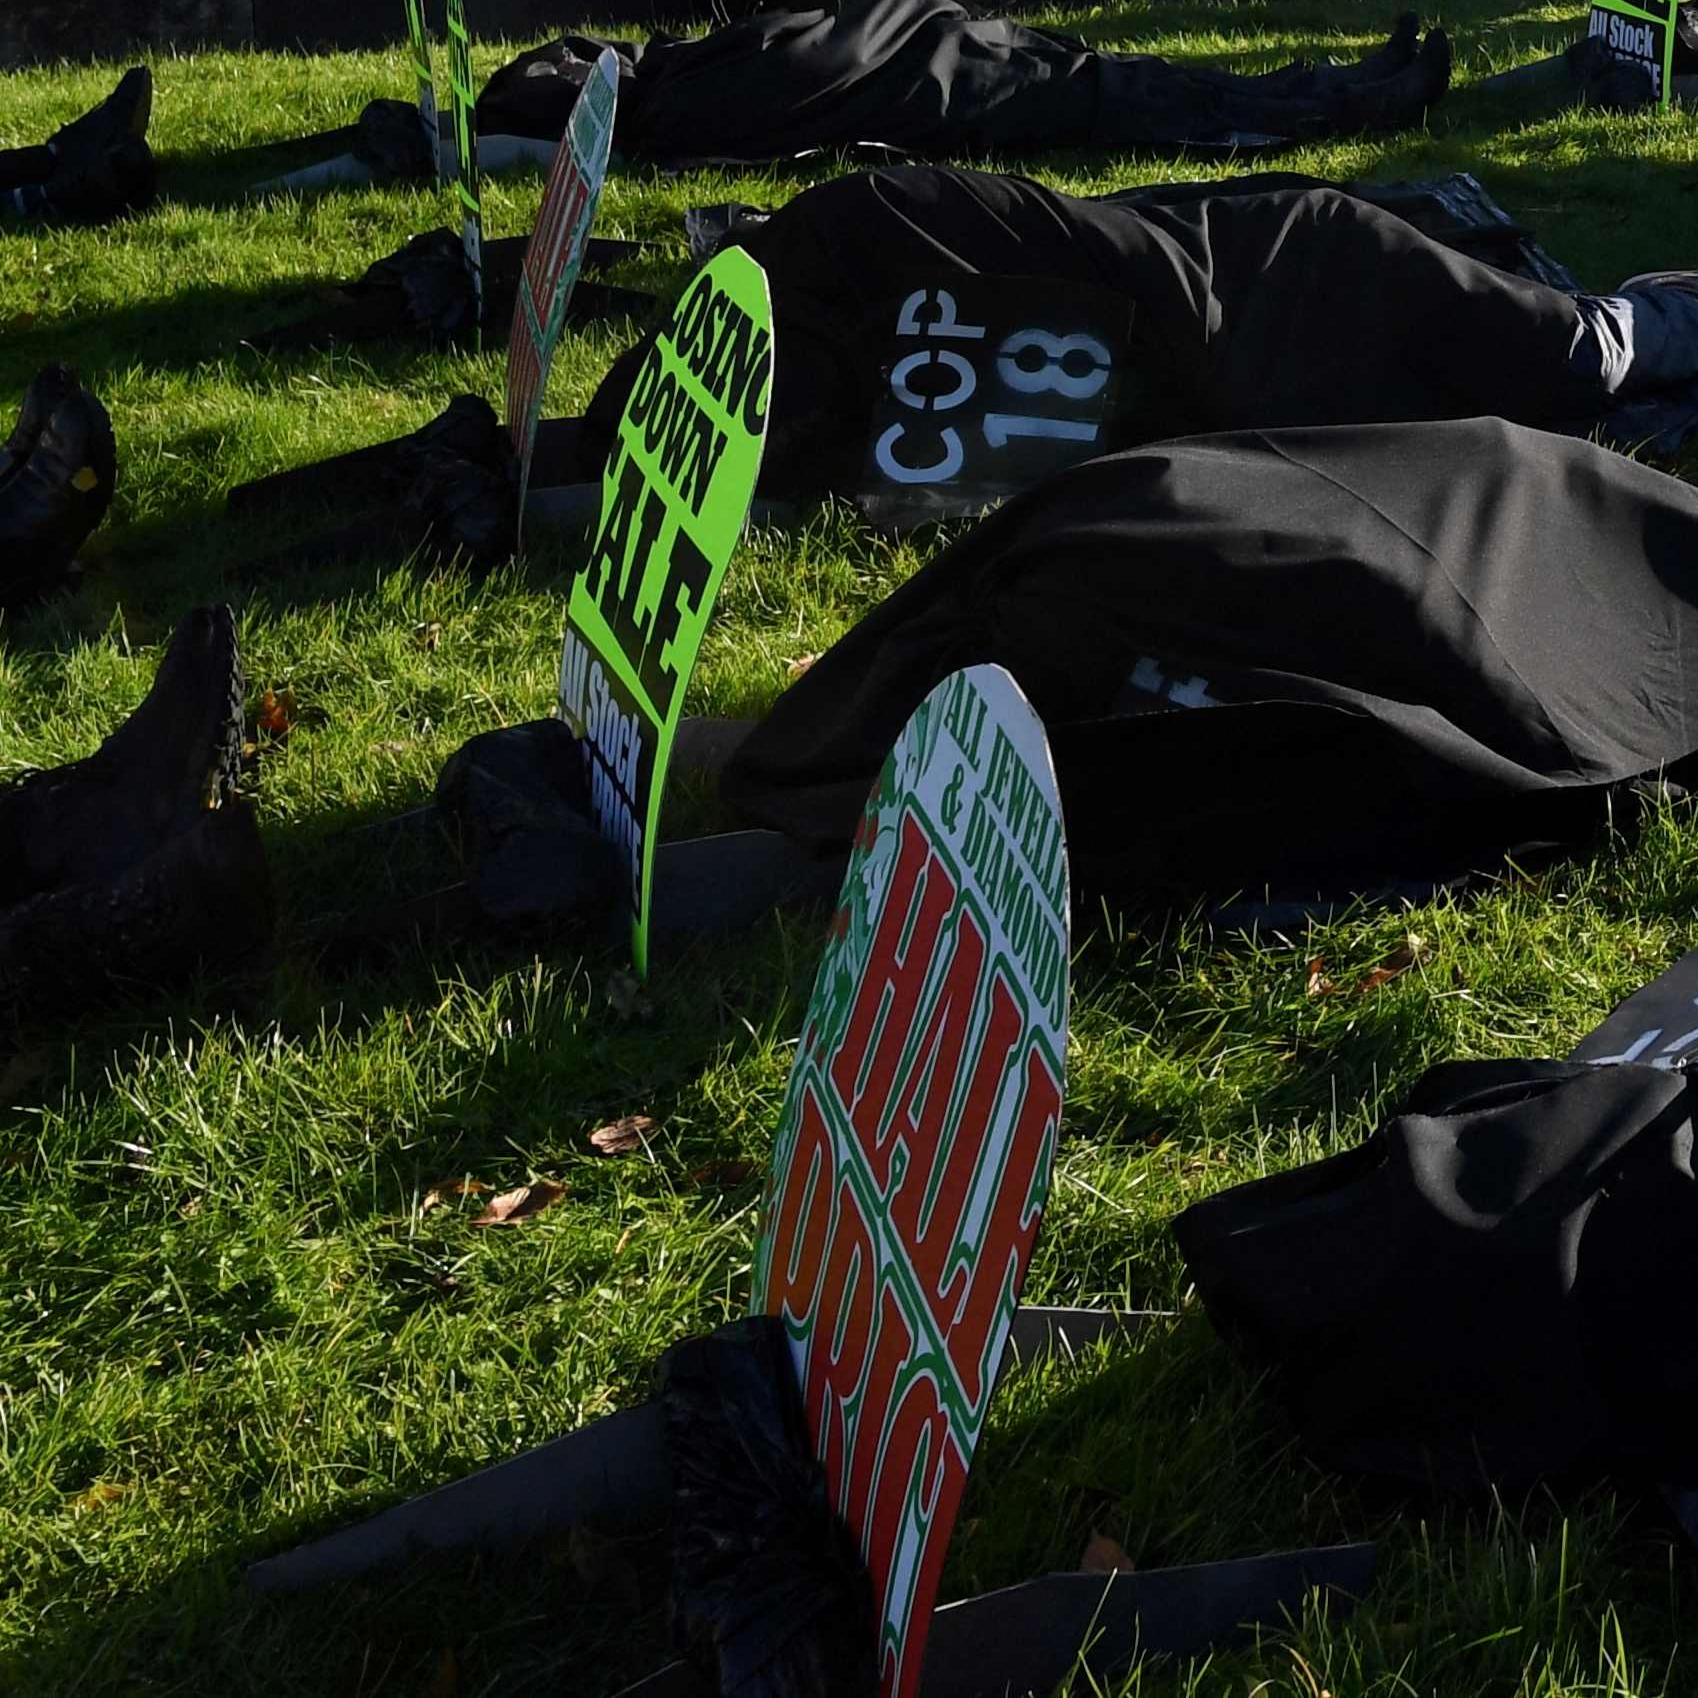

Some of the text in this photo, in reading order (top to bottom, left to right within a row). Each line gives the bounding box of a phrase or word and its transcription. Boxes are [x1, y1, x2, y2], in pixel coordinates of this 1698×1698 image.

[1609, 14, 1655, 58] Stock
[629, 338, 729, 519] DOWN
[875, 288, 986, 484] COP
[983, 328, 1112, 448] 18
[559, 627, 589, 723] All
[586, 660, 642, 807] Stock
[943, 669, 989, 774] ALL
[941, 763, 964, 835] &
[829, 809, 1062, 1410] HALF
